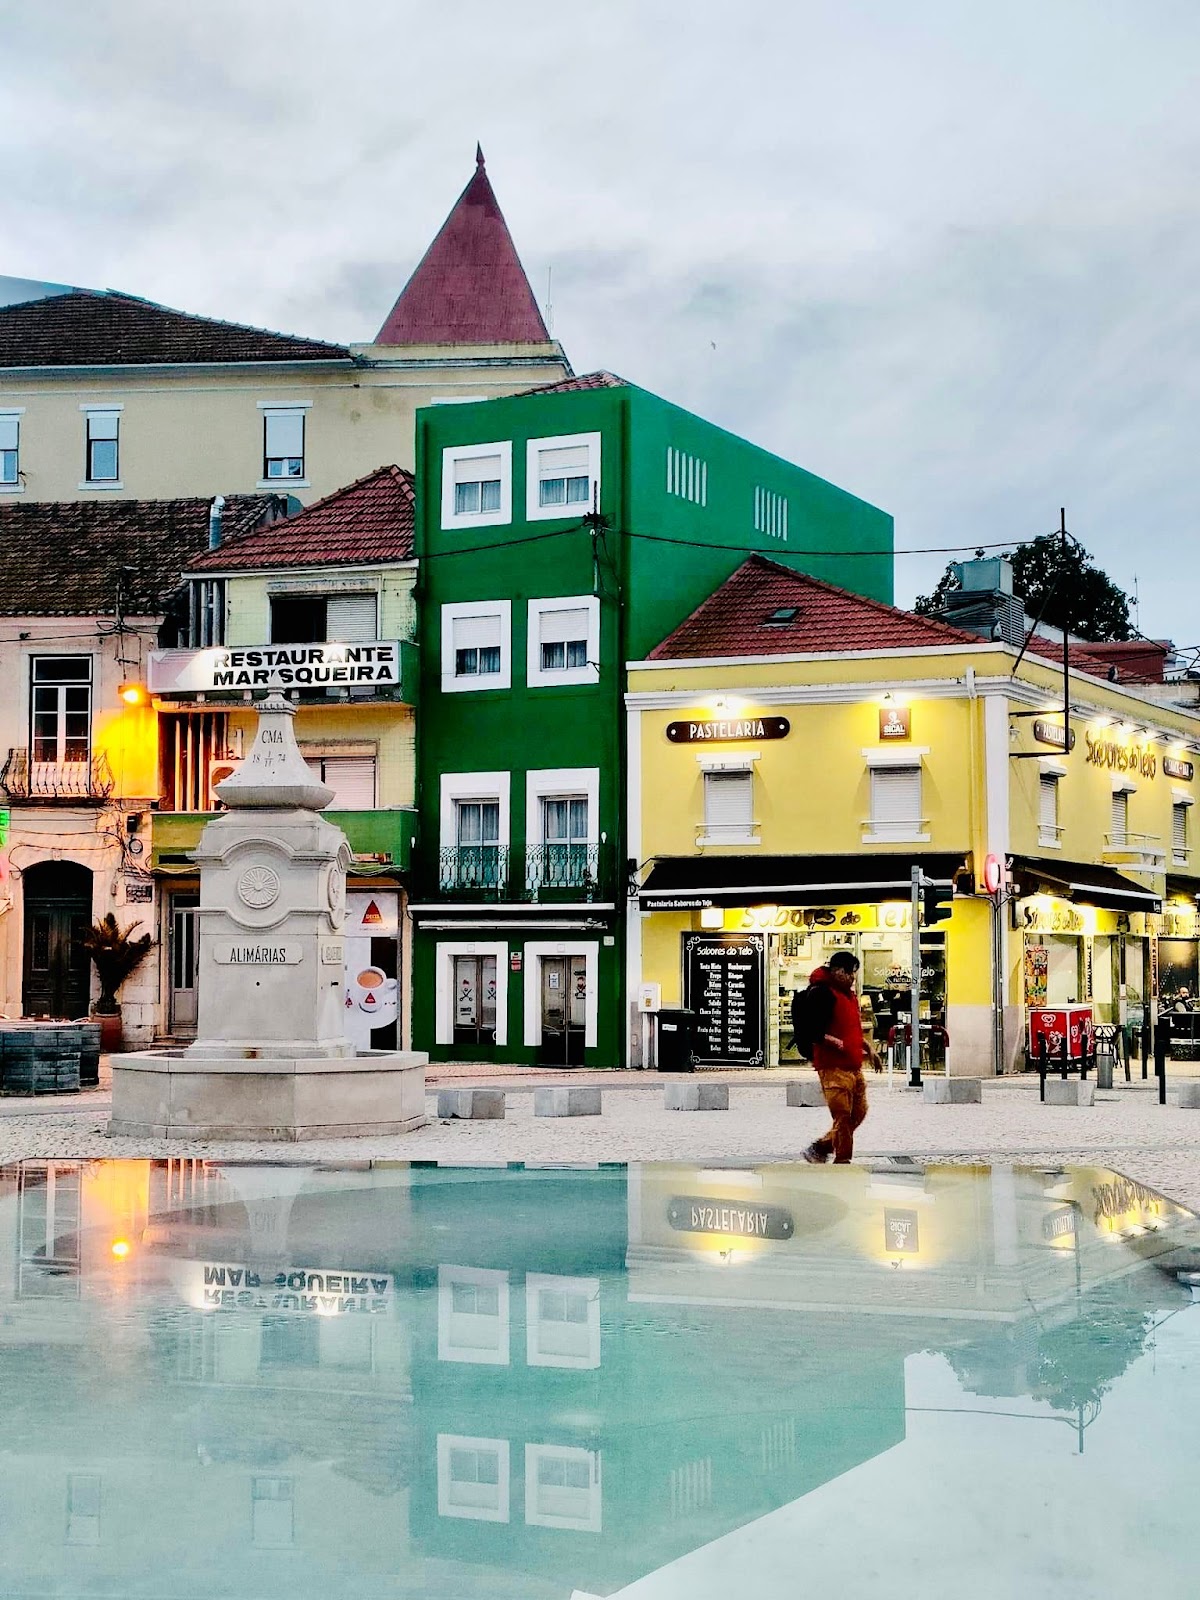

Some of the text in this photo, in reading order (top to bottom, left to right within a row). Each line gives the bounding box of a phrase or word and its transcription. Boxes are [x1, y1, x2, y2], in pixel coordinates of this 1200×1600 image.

[213, 646, 394, 668] RESTAURANTE
[213, 665, 393, 687] MARSQUEIRA
[261, 729, 283, 744] CMA
[689, 720, 765, 739] PASTELARIA
[883, 724, 906, 733] SICAL
[1085, 730, 1129, 773] Sabores
[646, 900, 674, 908] Pastelaria
[741, 906, 837, 928] Sabores
[840, 911, 861, 926] do
[229, 945, 287, 963] ALIMÁRIAS
[696, 946, 726, 956] Sabores
[726, 946, 738, 956] do
